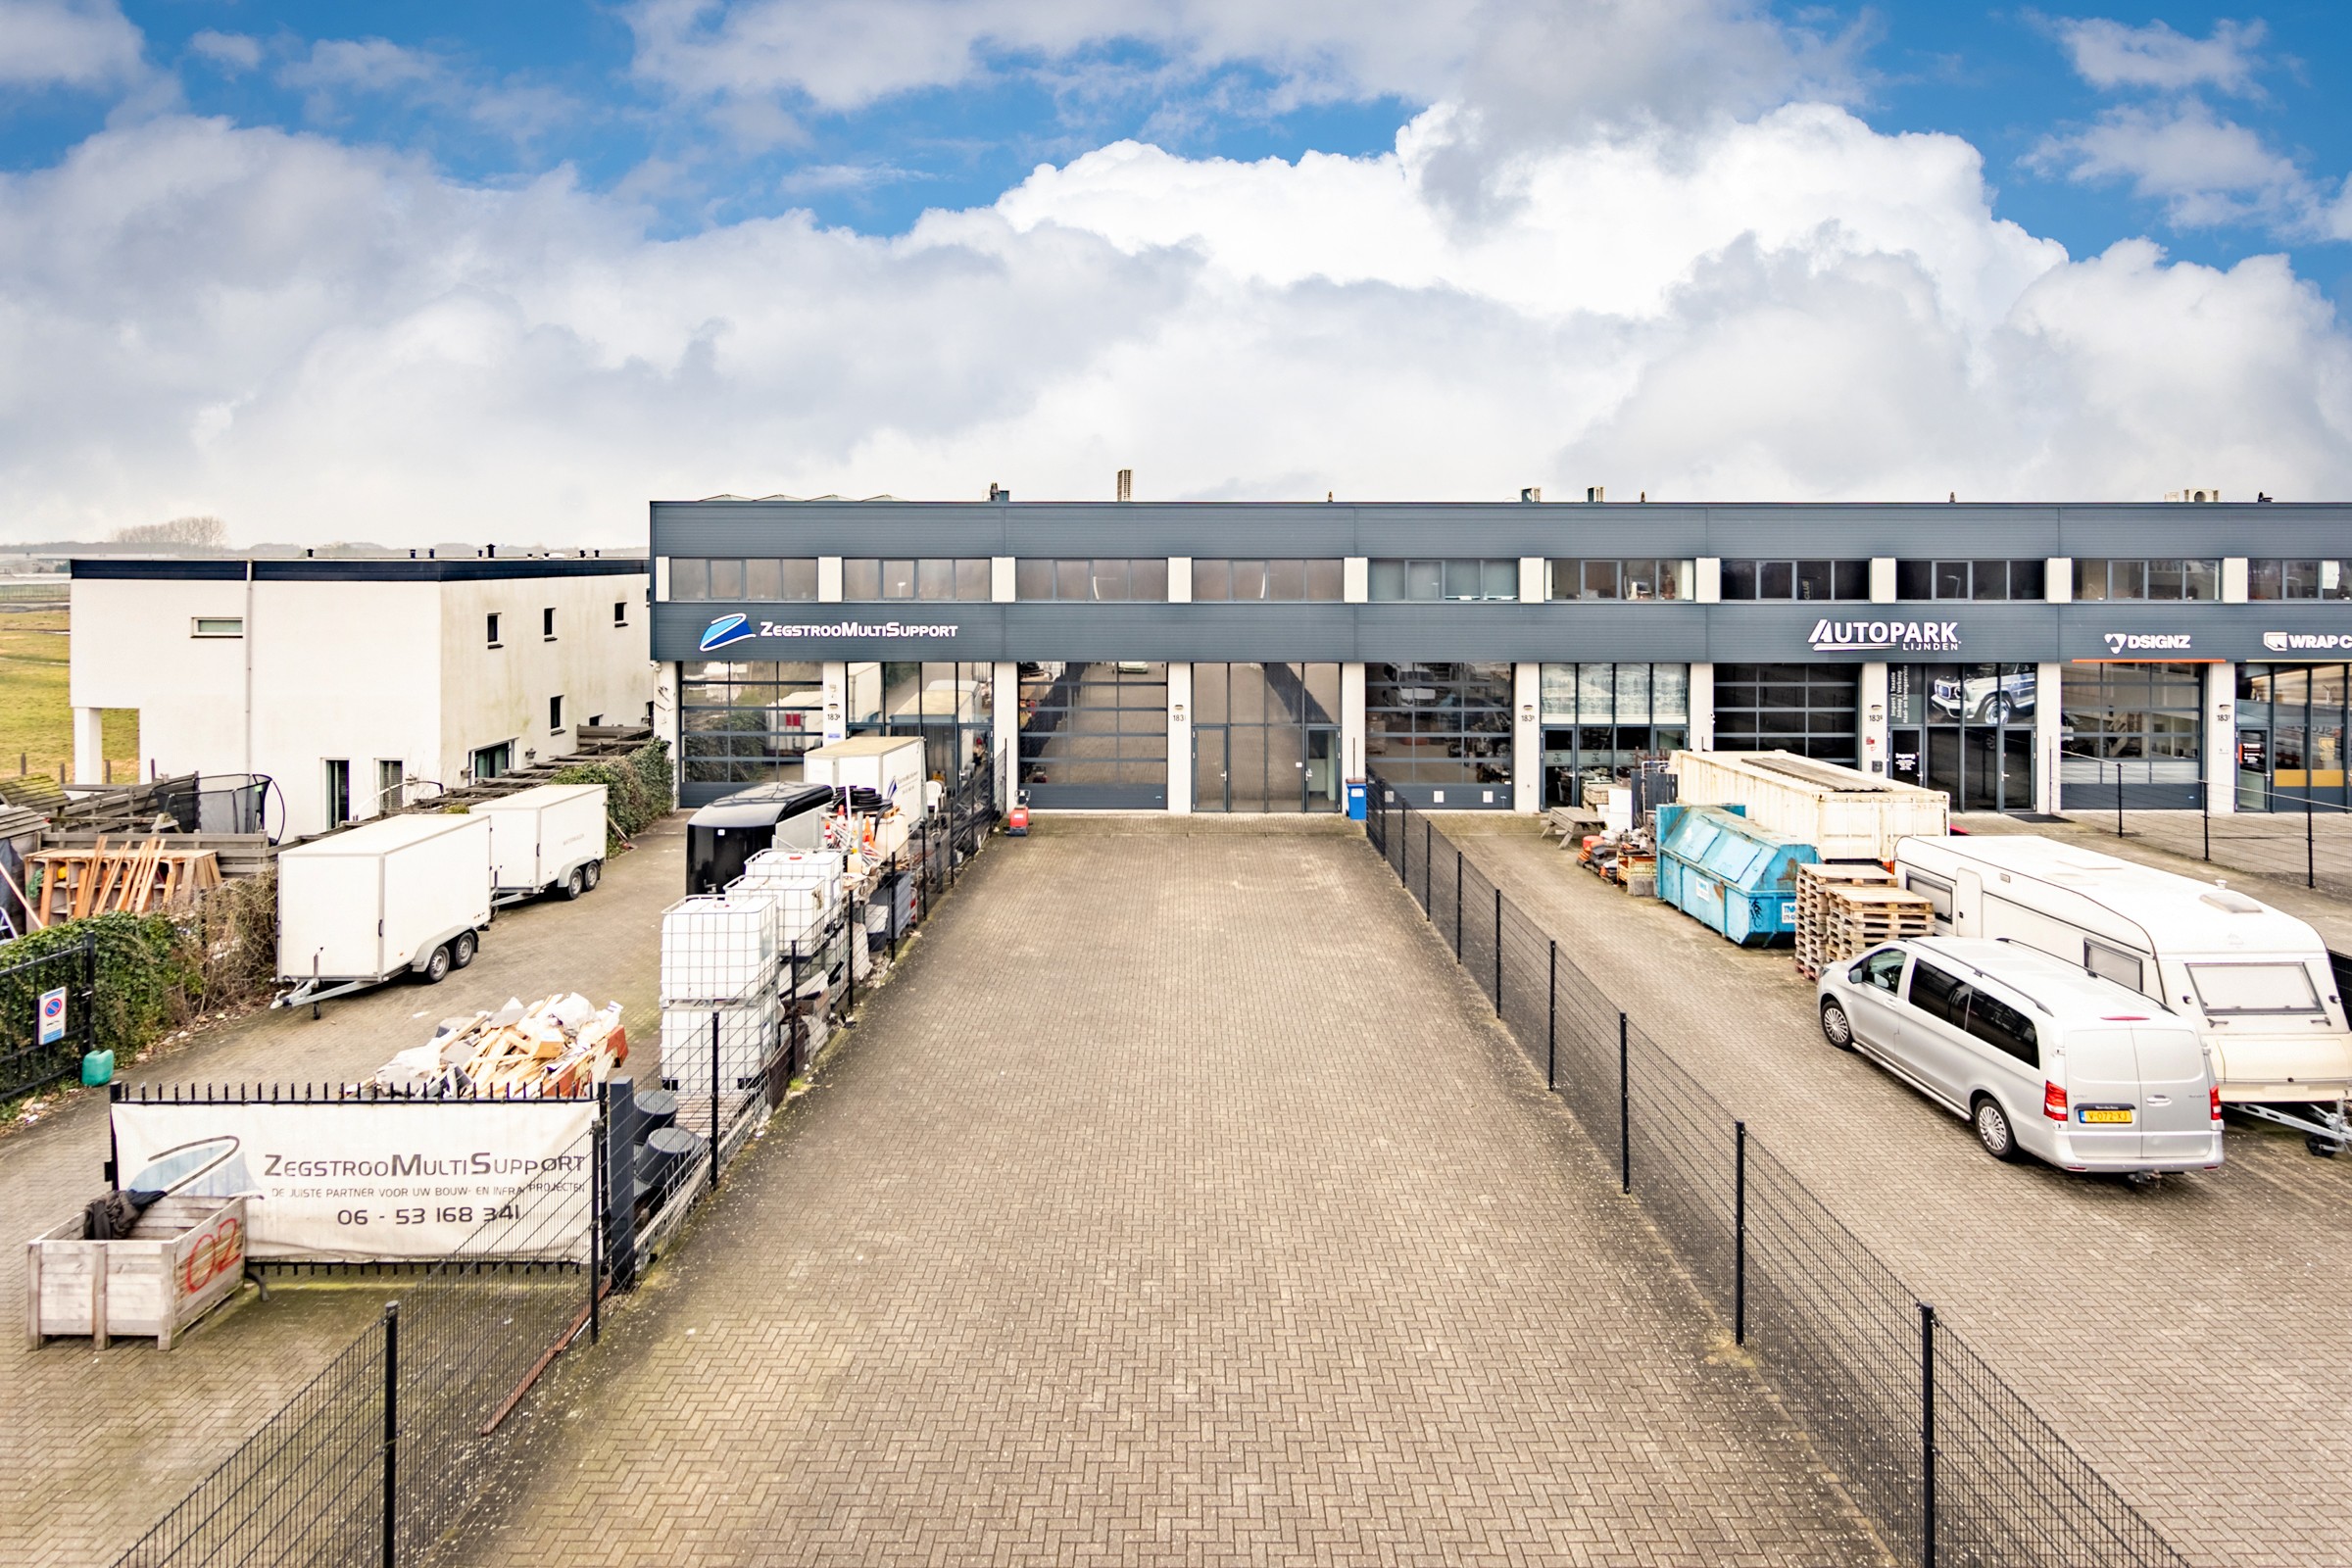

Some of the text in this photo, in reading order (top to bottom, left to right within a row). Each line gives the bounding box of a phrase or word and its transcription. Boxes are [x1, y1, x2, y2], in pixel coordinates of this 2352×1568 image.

[1807, 619, 1959, 643] AUTOPARK
[2128, 635, 2190, 649] DSIGNZ
[2288, 635, 2338, 649] WRAP
[271, 1188, 284, 1198] DE
[289, 1188, 321, 1198] JUISTE
[325, 1188, 374, 1198] PARTNER
[379, 1188, 409, 1198] VOOR
[413, 1188, 431, 1197] UW
[475, 1187, 489, 1196] EN
[528, 1182, 585, 1193] PROJECTEN
[337, 1209, 368, 1225] 06
[396, 1207, 425, 1225] 53
[436, 1206, 473, 1223] 168
[483, 1204, 519, 1222] 341
